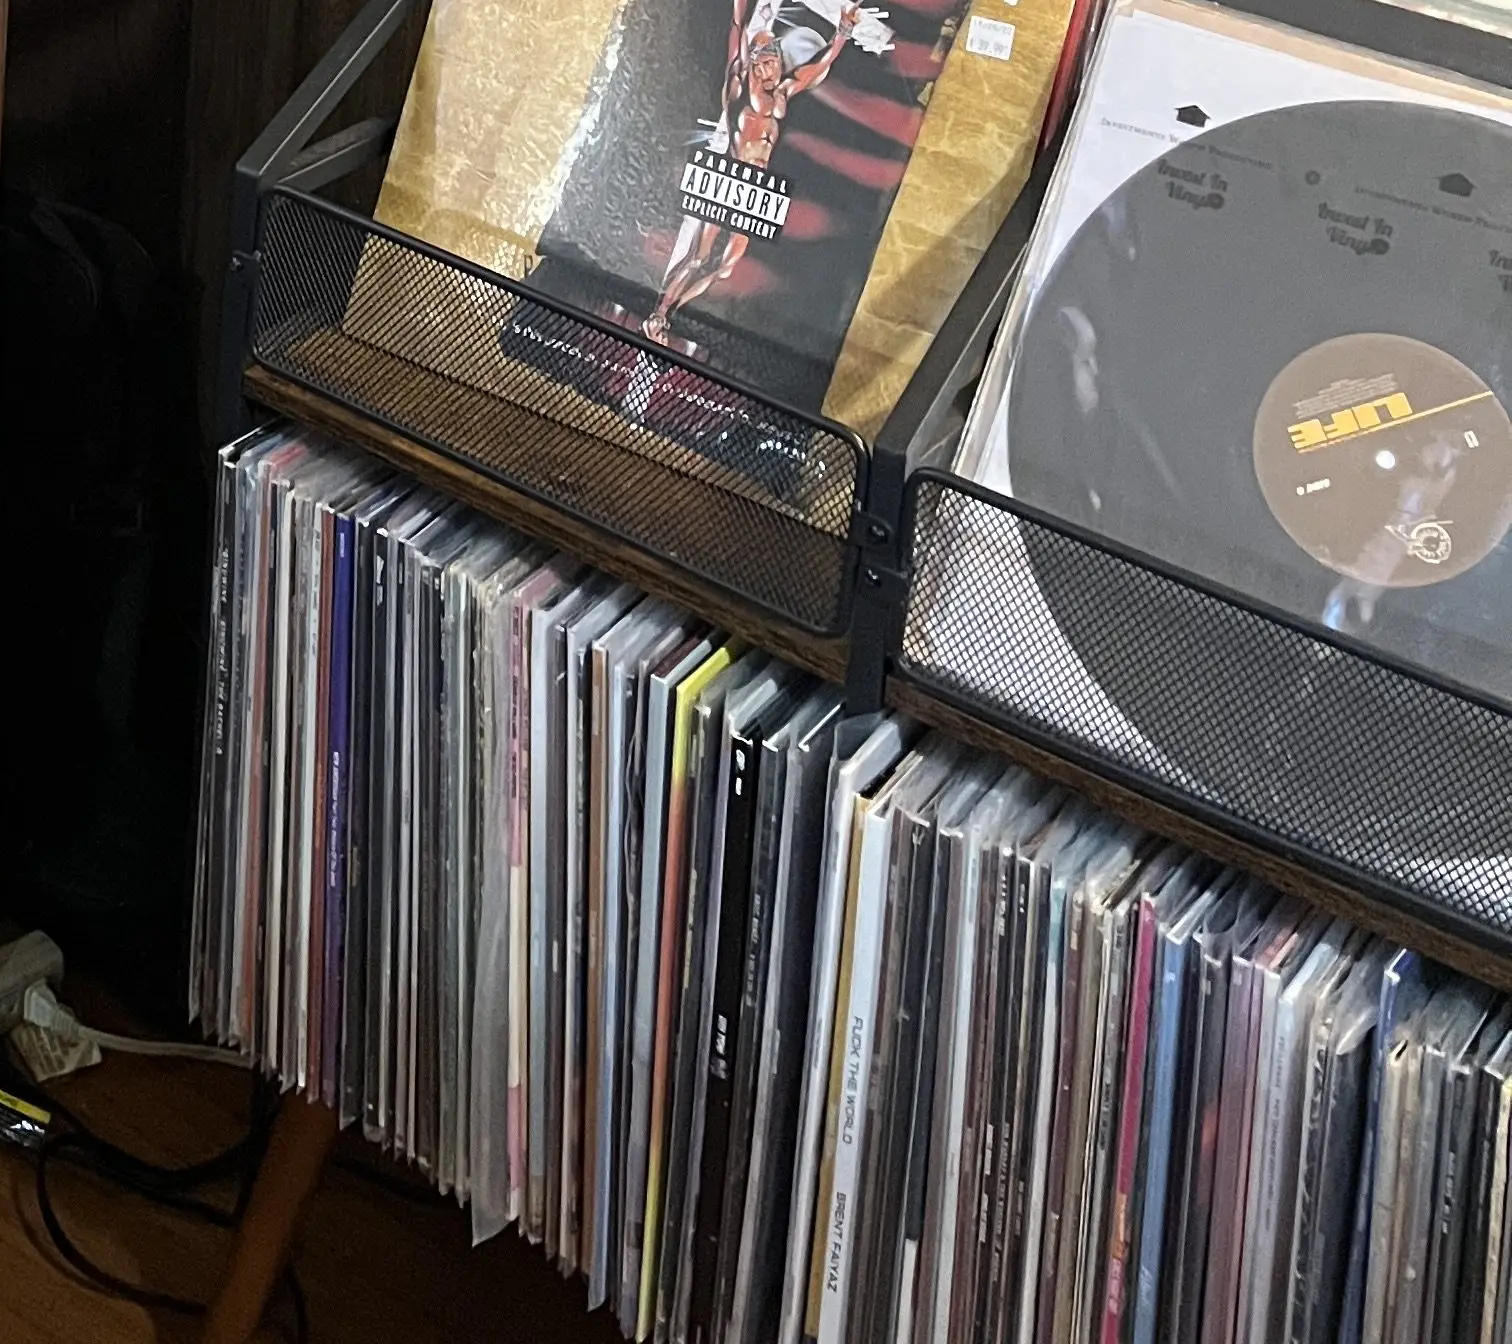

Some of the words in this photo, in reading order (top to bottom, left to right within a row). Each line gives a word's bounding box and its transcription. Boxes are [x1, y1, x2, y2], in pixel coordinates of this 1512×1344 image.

[685, 166, 788, 220] ADVISORY
[693, 150, 788, 194] PARENTAL
[681, 197, 728, 226] EXPLICIT
[728, 210, 779, 240] CONTENT
[1286, 391, 1415, 453] LIFE
[852, 1015, 865, 1058] FUCK
[848, 1058, 860, 1093] THE
[841, 1094, 857, 1145] WORLD
[833, 1191, 847, 1239] BRENT
[826, 1240, 842, 1294] FAIYAZ
